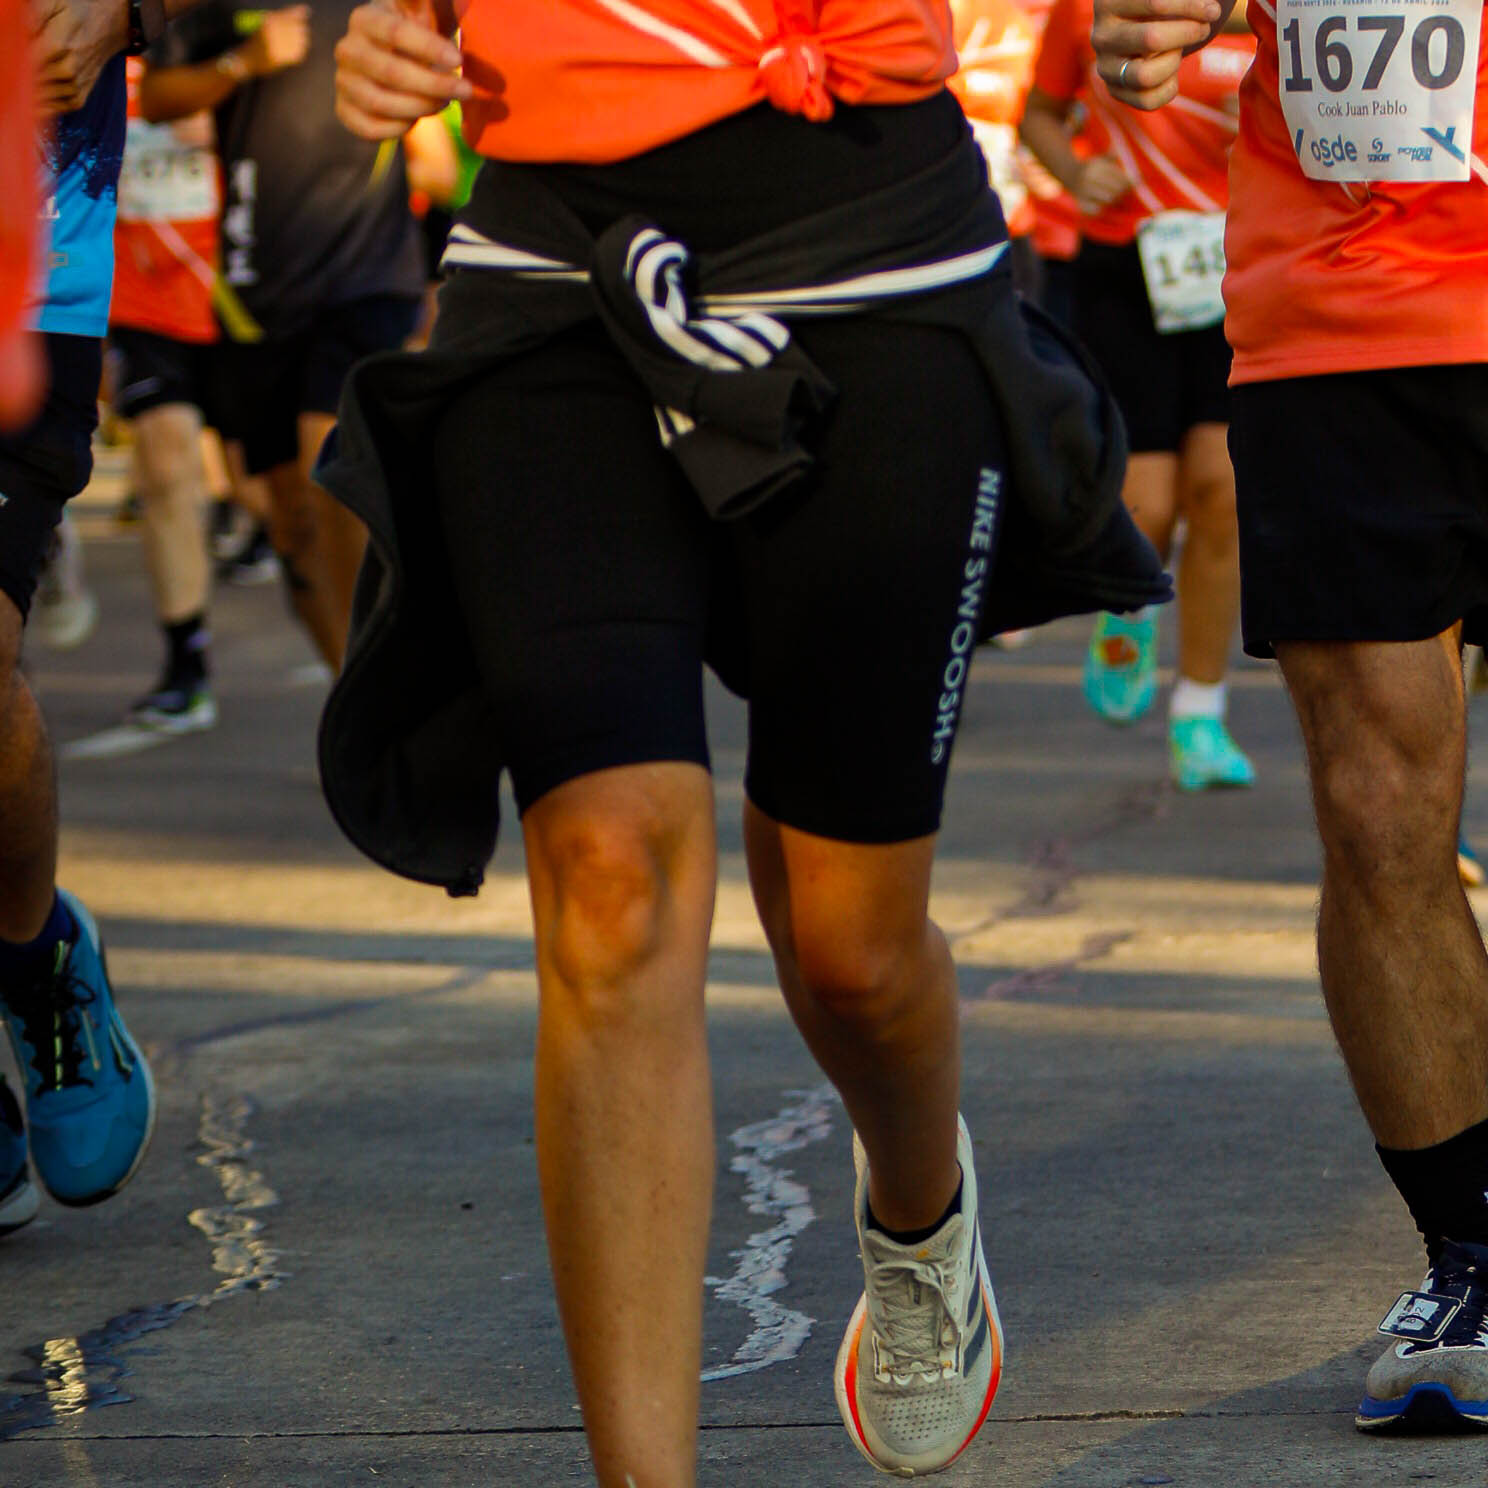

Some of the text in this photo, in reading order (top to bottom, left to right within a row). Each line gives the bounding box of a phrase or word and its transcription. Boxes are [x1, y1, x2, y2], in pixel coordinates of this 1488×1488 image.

[1283, 15, 1465, 93] 1670
[1317, 100, 1408, 117] Cook Juan Pablo
[1310, 133, 1357, 162] osde
[931, 467, 1001, 739] NIKE SWOOSH
